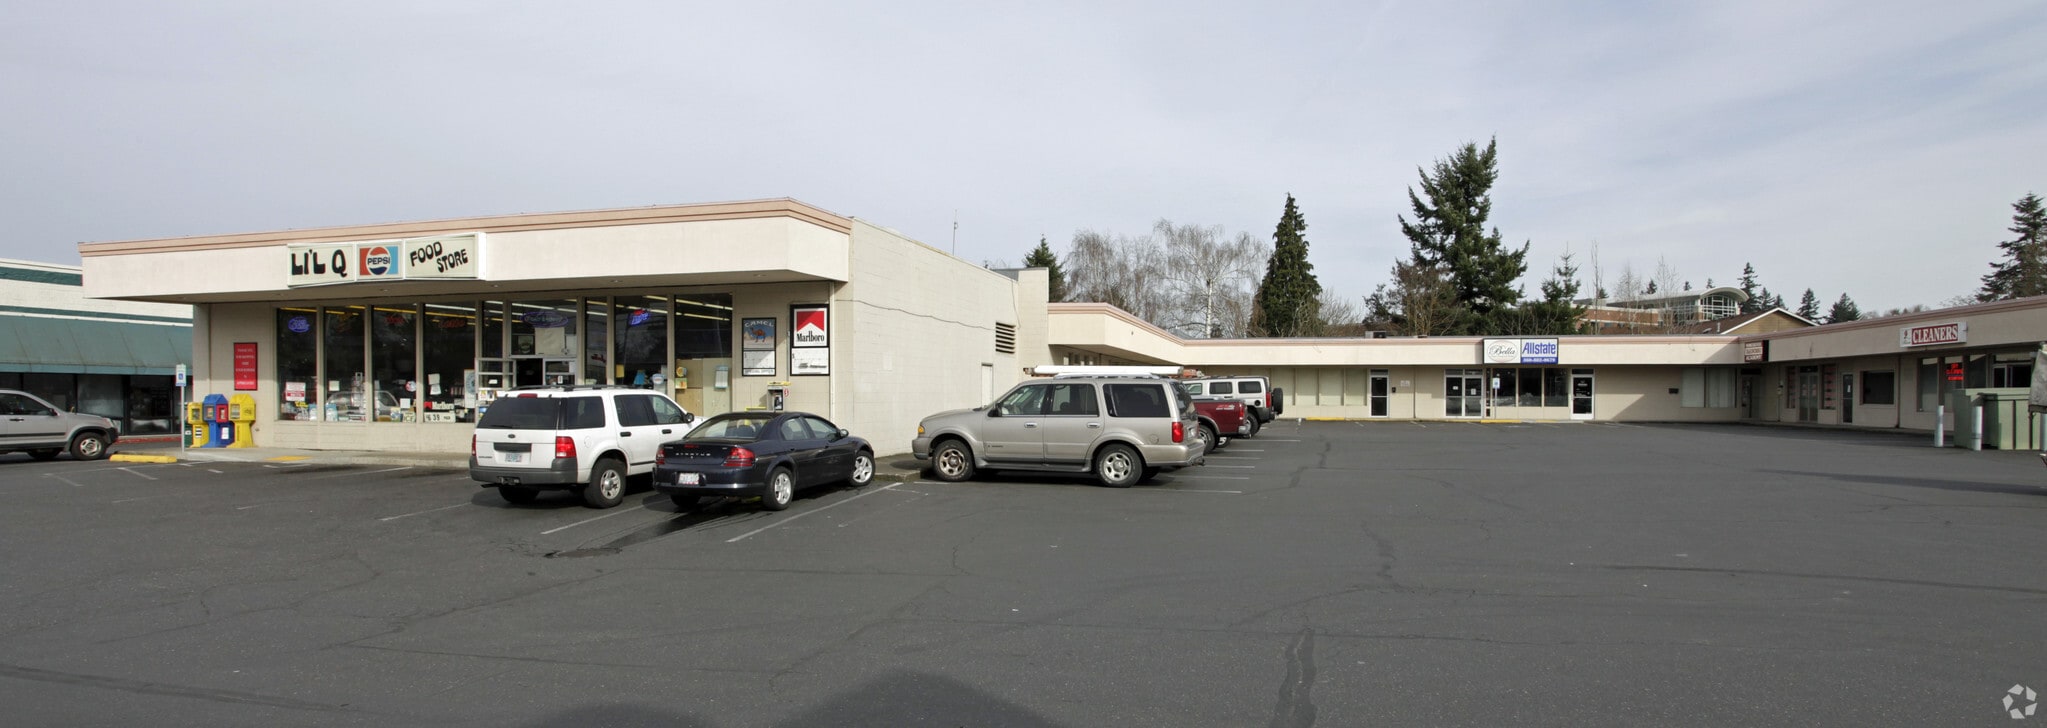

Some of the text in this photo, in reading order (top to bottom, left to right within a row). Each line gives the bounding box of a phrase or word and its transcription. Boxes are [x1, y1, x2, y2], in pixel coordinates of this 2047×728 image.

[409, 241, 443, 267] FOOD
[291, 249, 348, 278] LI'L Q
[367, 256, 391, 266] PEPSI
[436, 248, 469, 273] STORE
[744, 320, 774, 328] CAMEL
[796, 330, 825, 342] Marlboro
[1912, 325, 1958, 344] CLEANERS
[1488, 344, 1516, 356] Bella
[1522, 342, 1556, 354] Allstate
